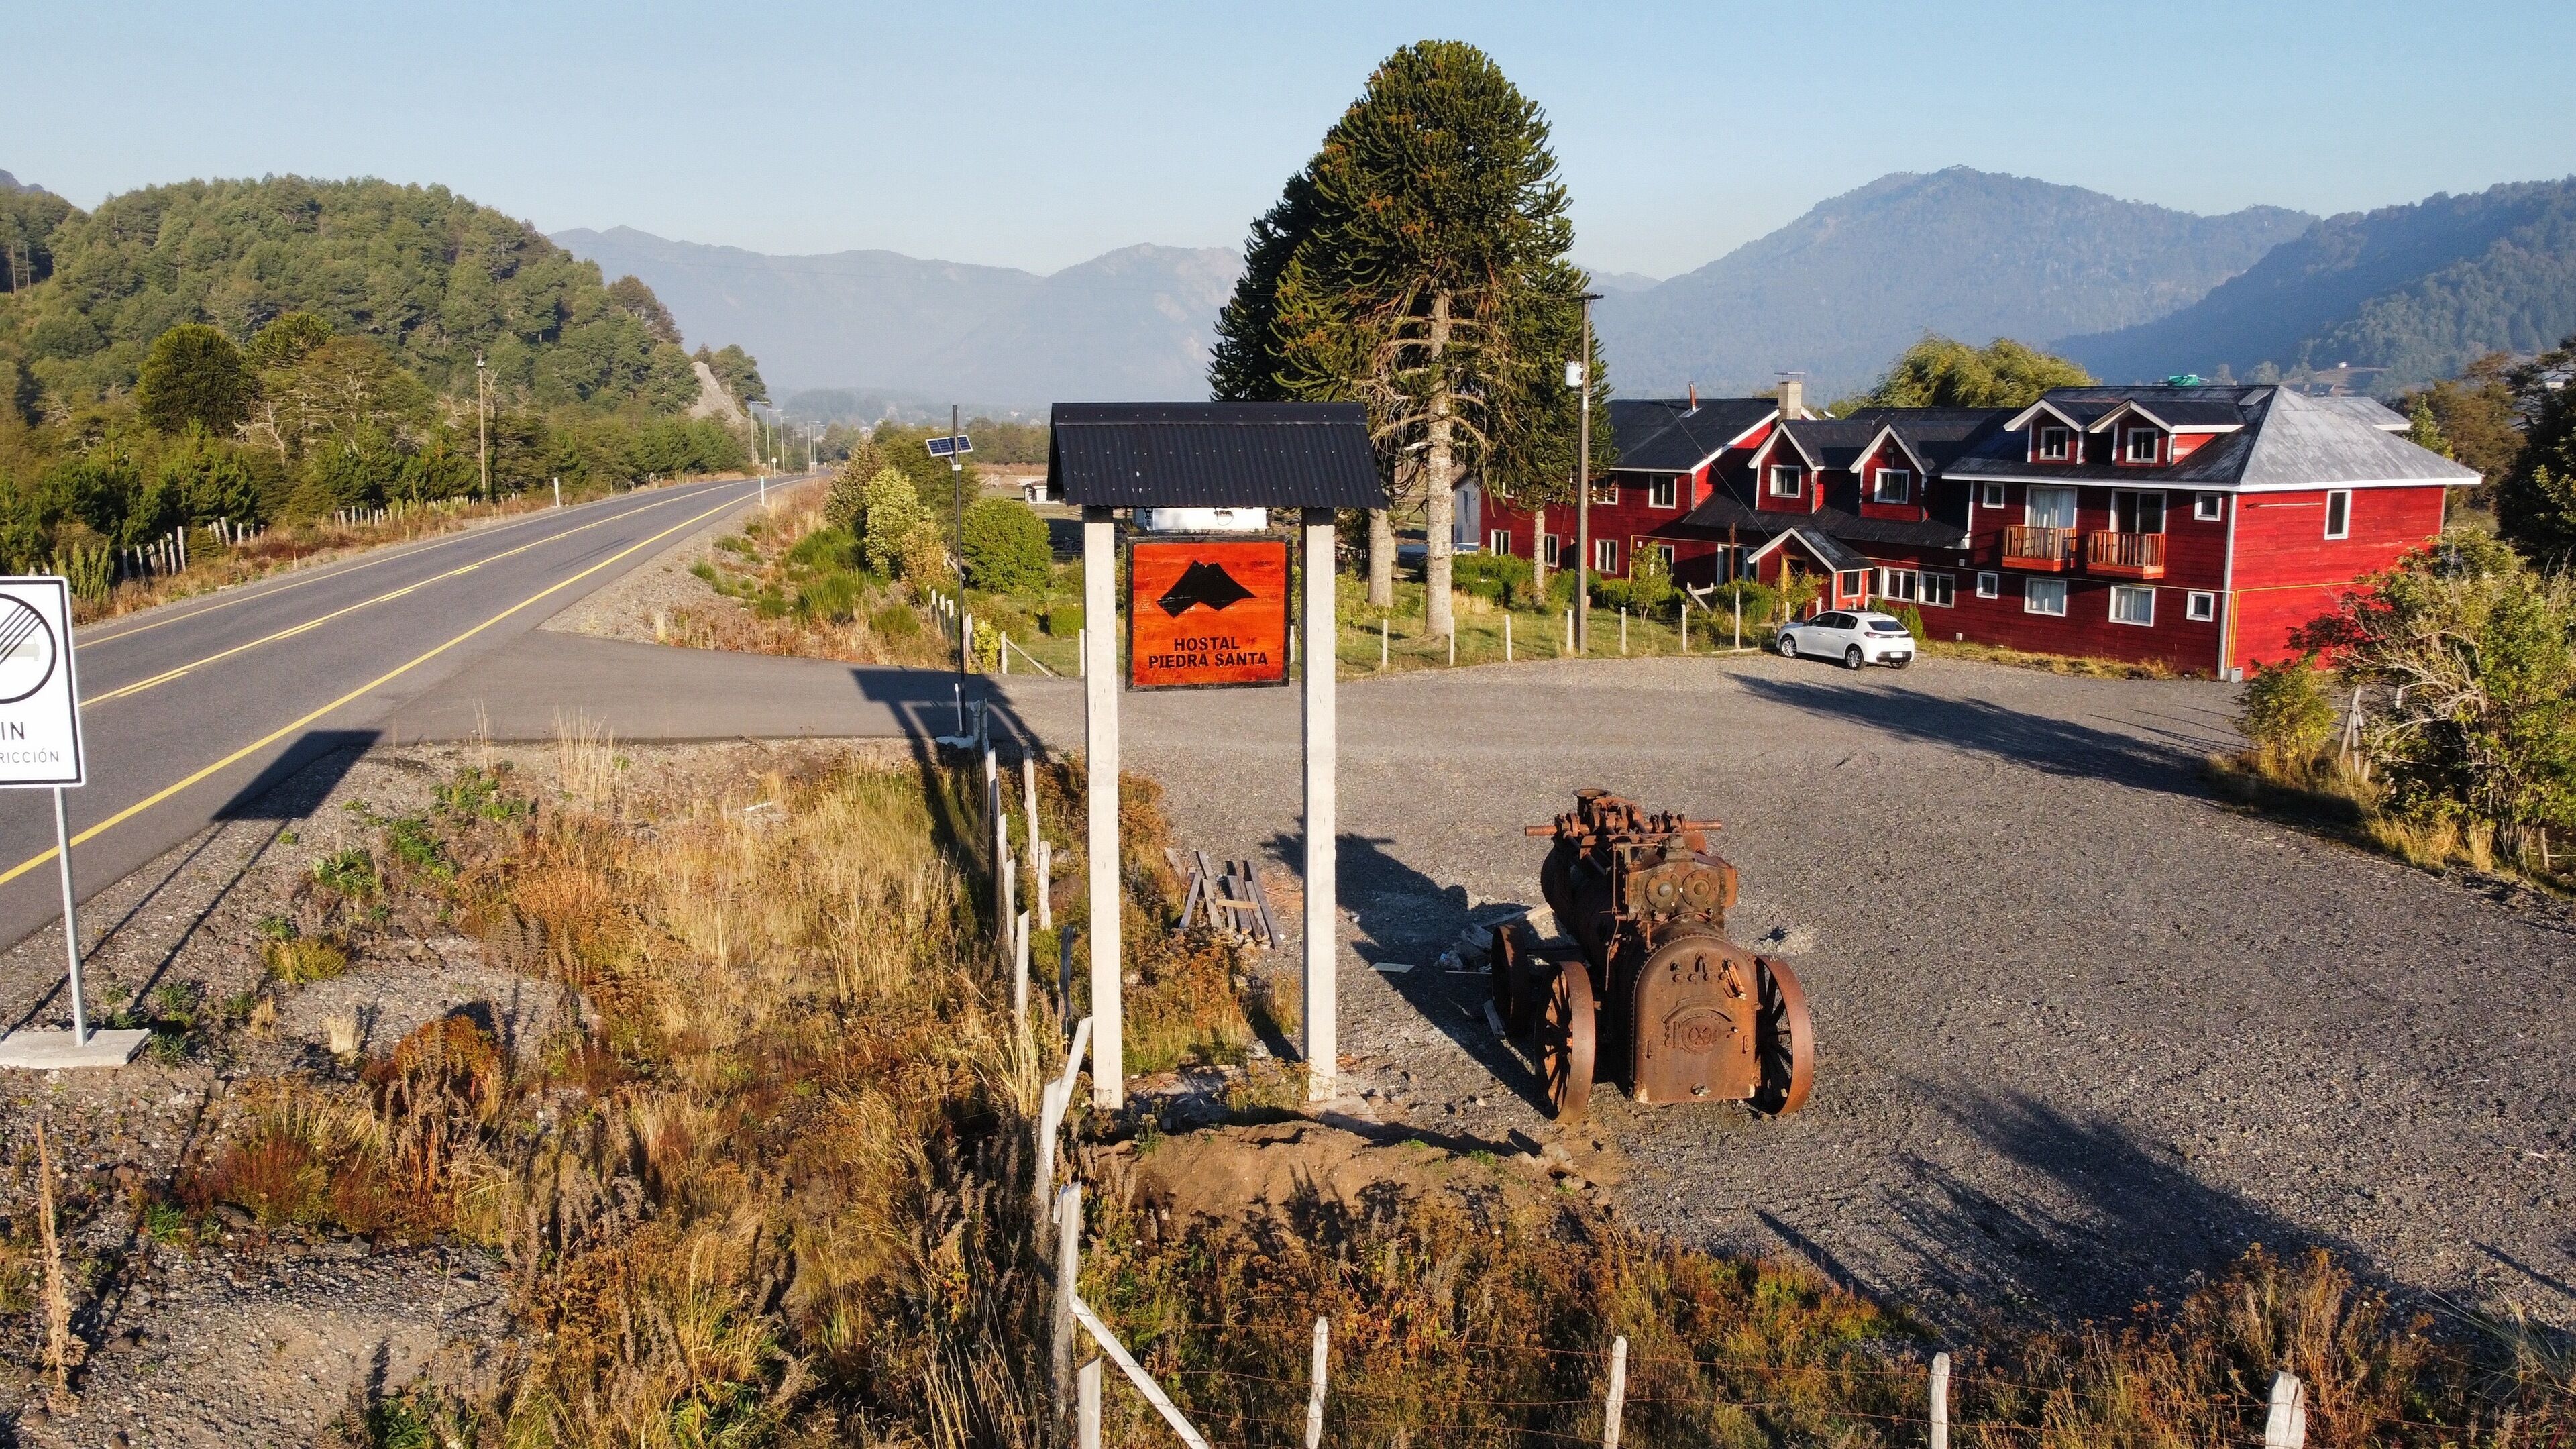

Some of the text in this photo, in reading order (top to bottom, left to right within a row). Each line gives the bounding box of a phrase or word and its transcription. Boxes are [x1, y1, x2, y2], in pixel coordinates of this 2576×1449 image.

[1174, 637, 1240, 651] HOSTAL
[1148, 652, 1268, 669] PIEDRA SANTA
